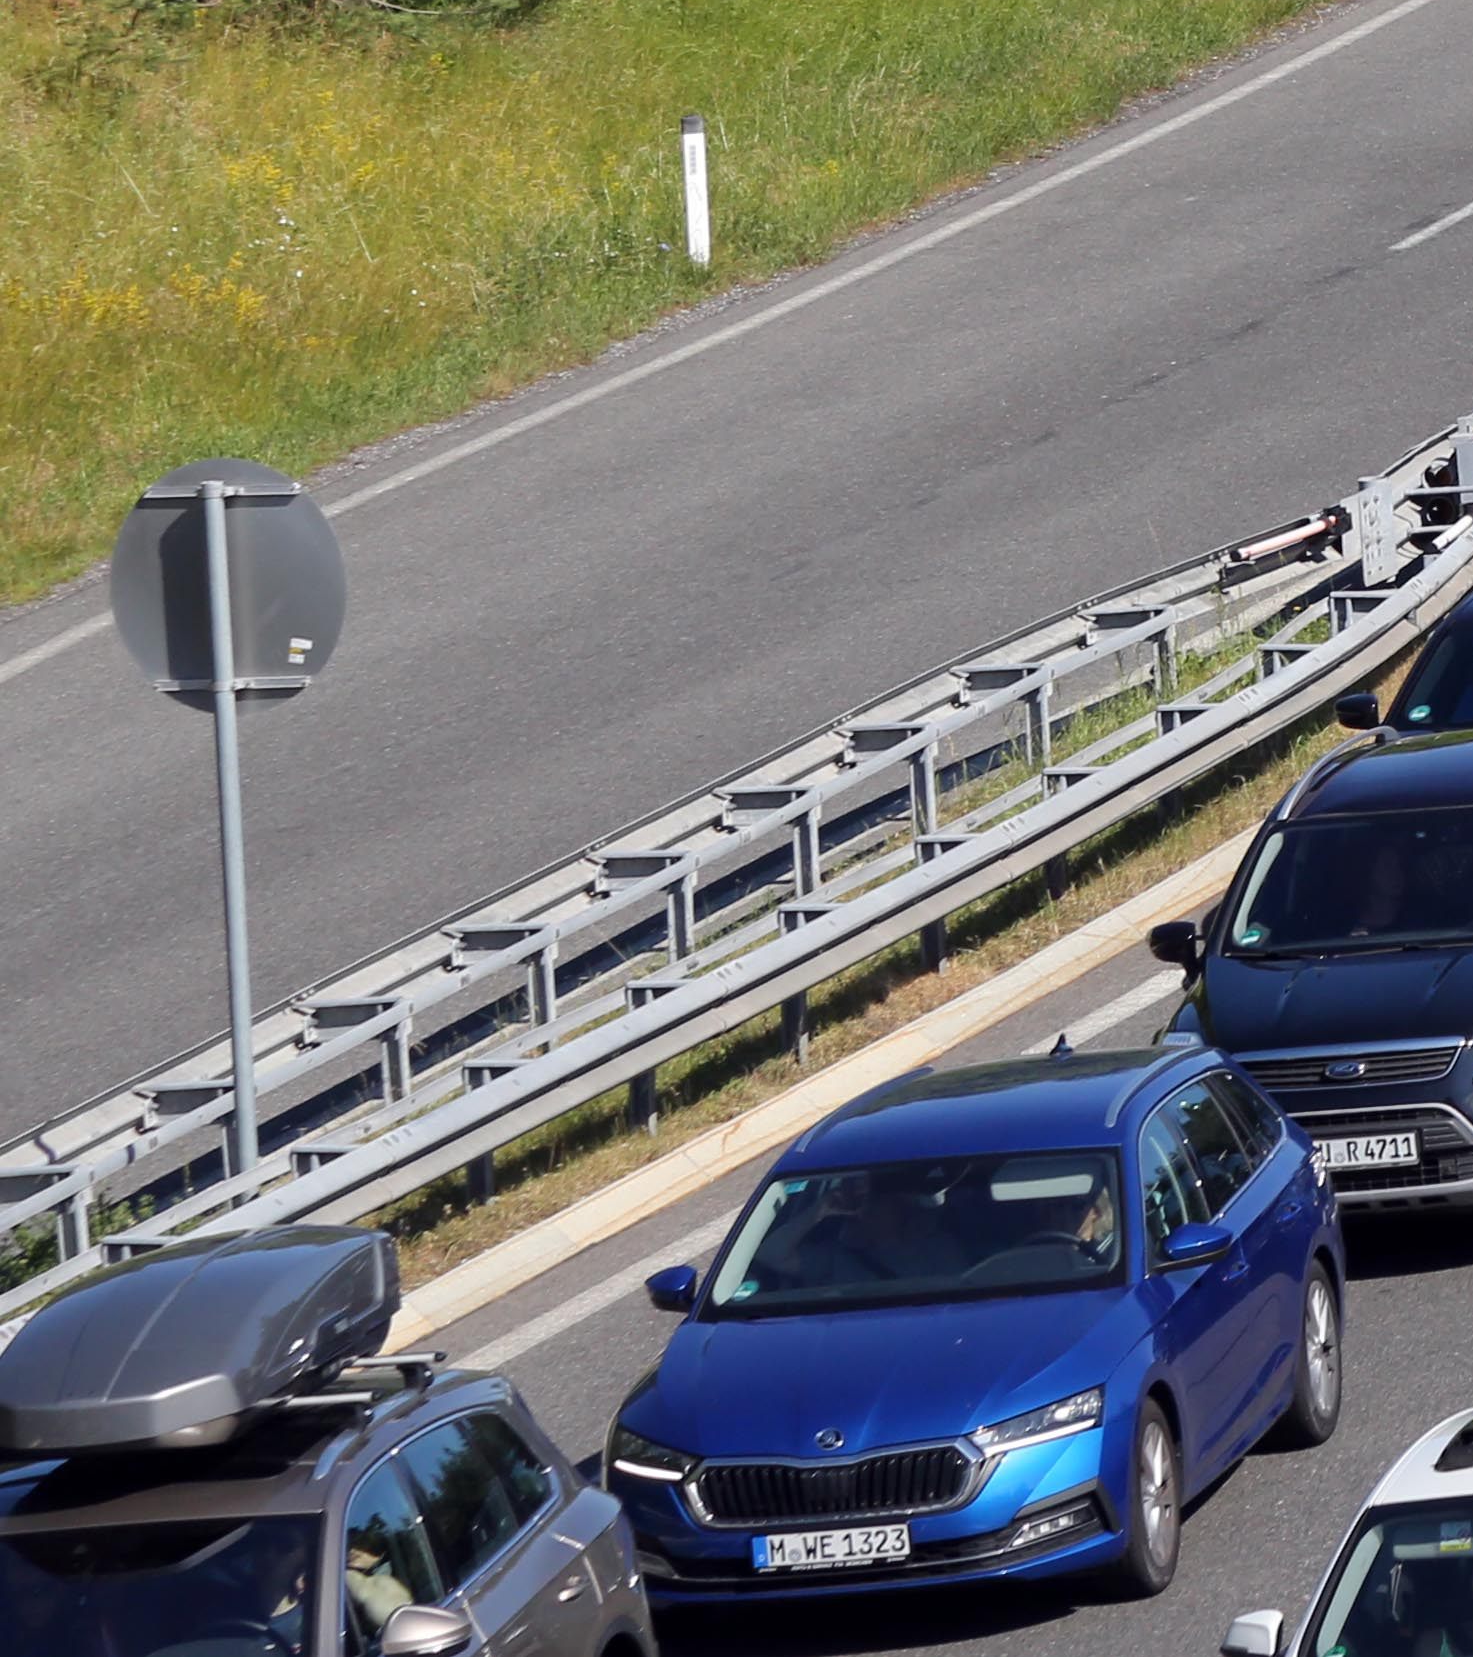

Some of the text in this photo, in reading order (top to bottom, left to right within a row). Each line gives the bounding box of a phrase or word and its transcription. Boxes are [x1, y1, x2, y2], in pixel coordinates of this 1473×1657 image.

[1346, 1140, 1360, 1162] R
[1364, 1136, 1414, 1160] 4711
[769, 1538, 787, 1563] M
[803, 1534, 837, 1560] WE
[841, 1528, 906, 1557] 1323
